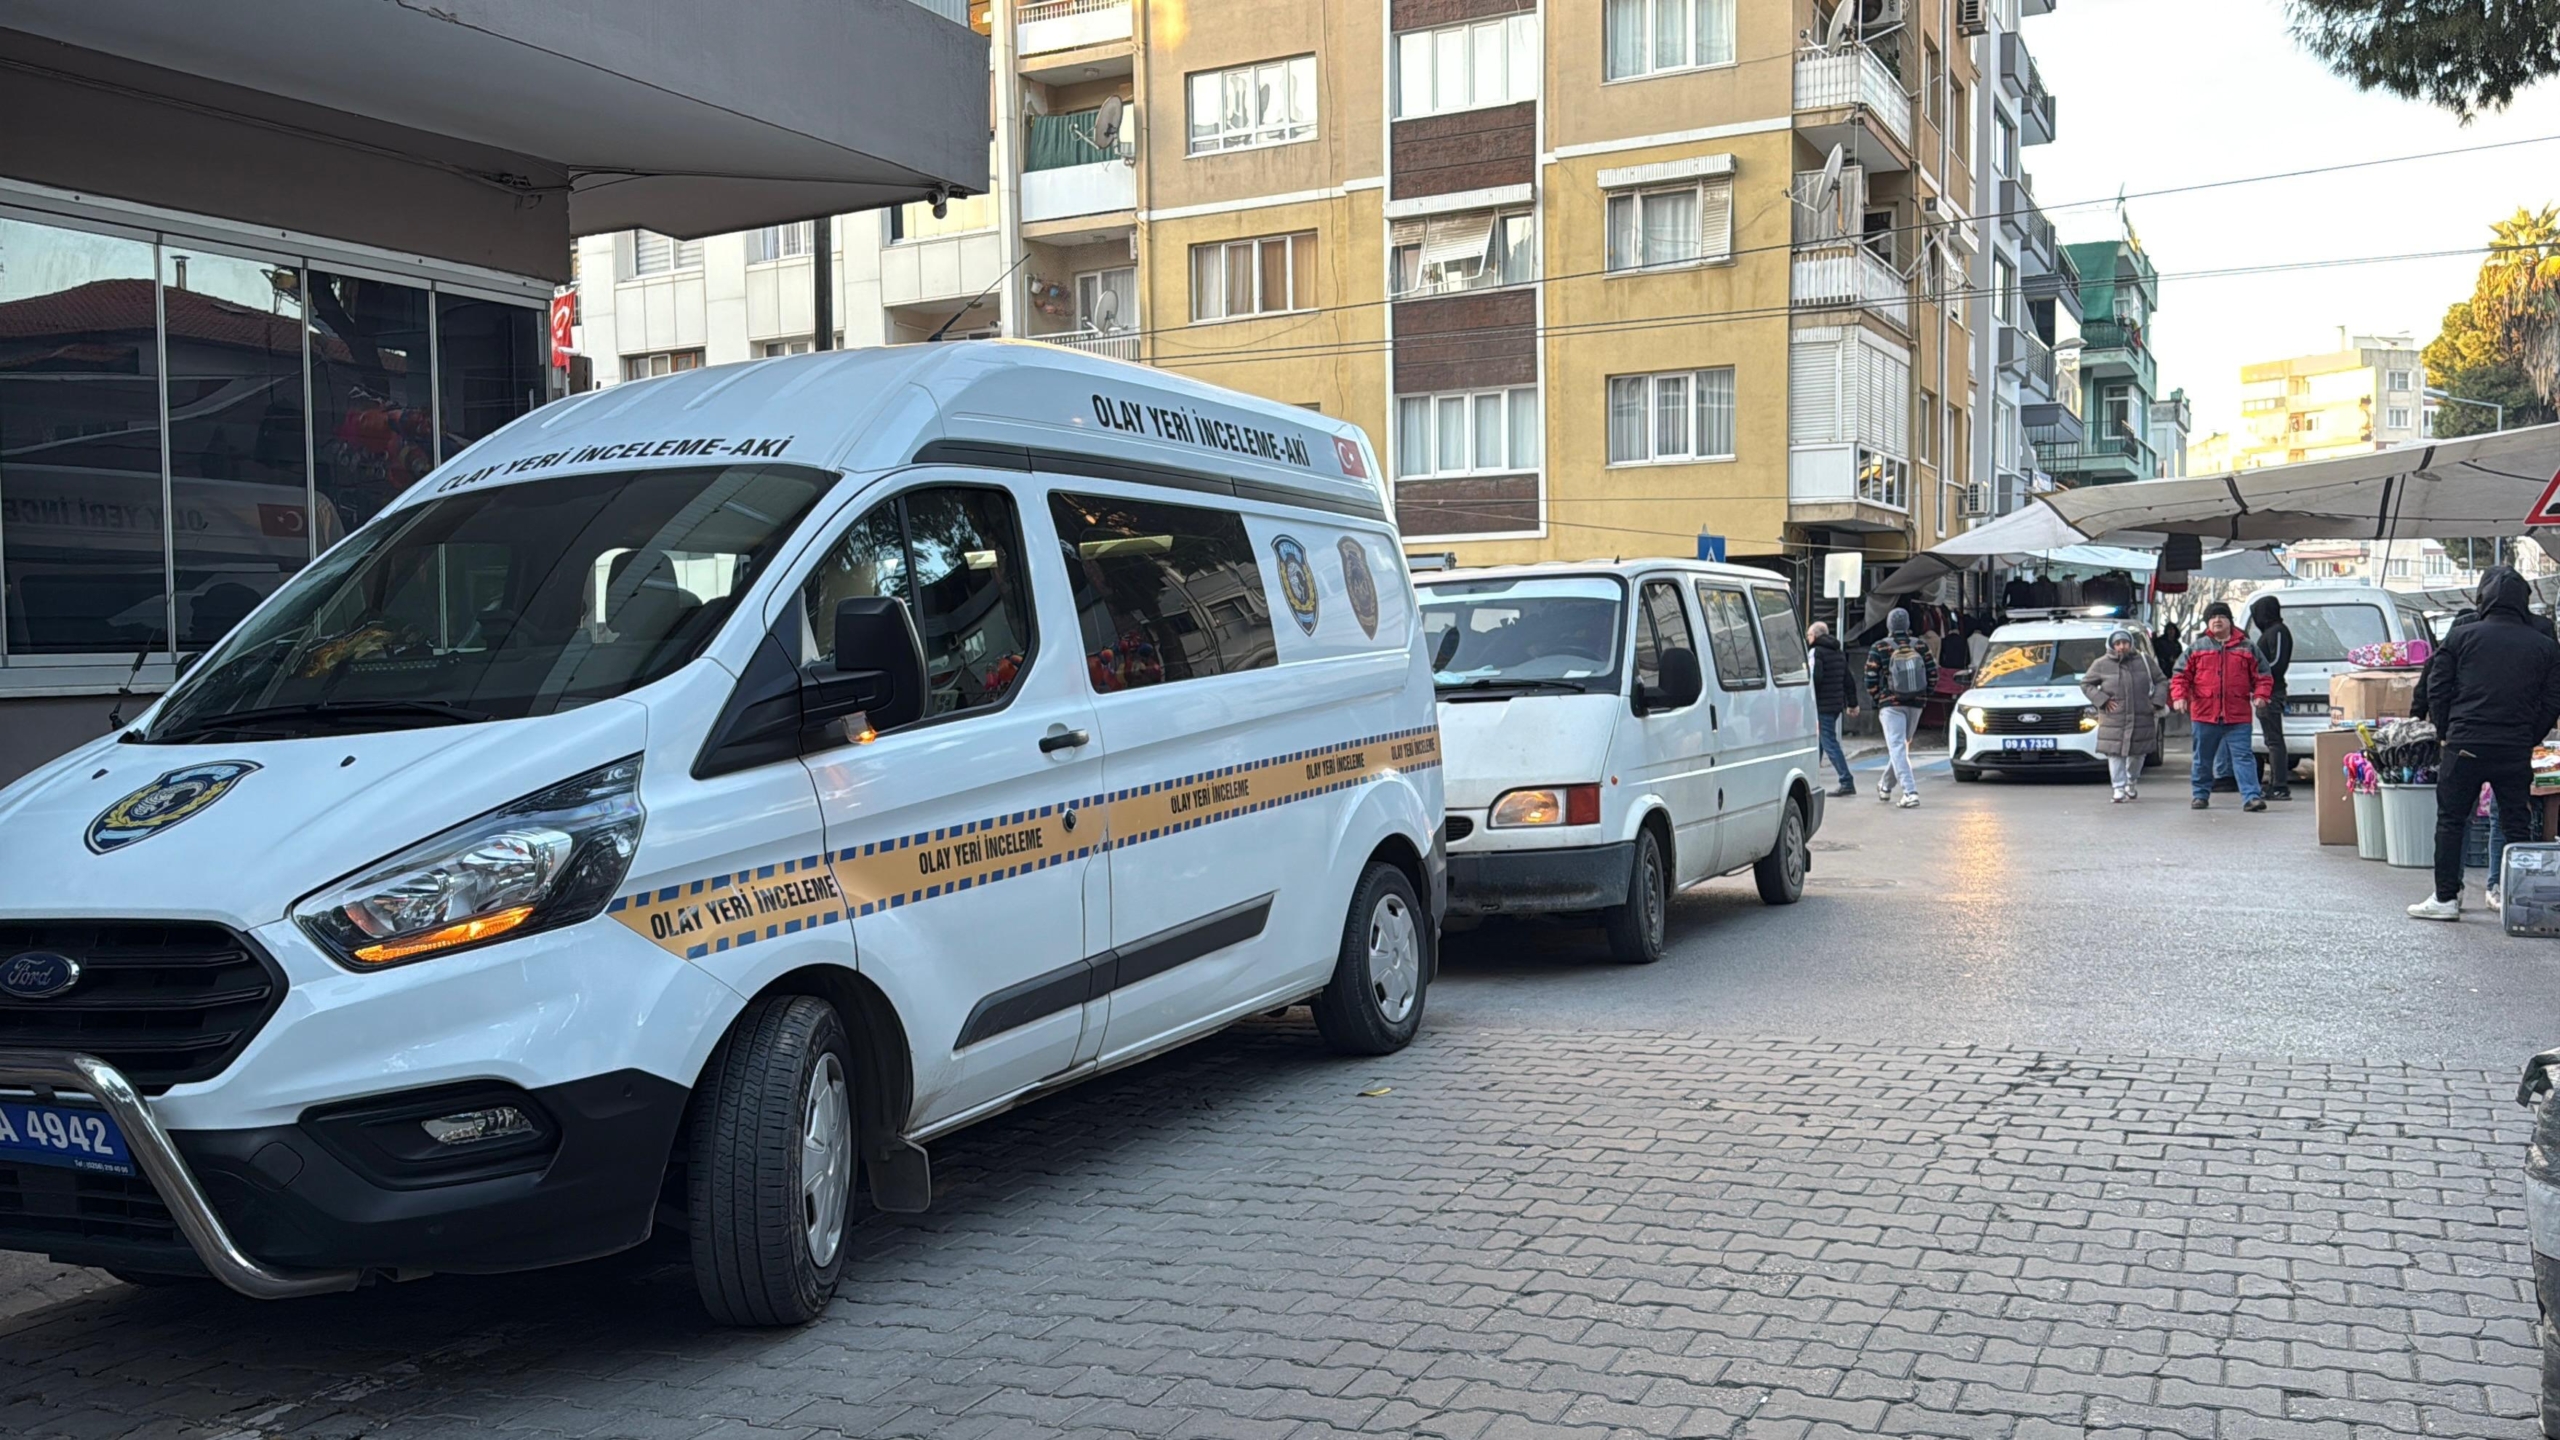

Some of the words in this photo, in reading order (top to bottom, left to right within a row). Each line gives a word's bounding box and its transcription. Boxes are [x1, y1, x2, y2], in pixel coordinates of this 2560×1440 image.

[1092, 394, 1145, 434] OLAY
[1147, 405, 1195, 443] YERİ
[1193, 408, 1311, 467] İNCELEME-AKİ
[501, 447, 571, 476] YERİ
[568, 436, 795, 465] İNCELEME-AKİ
[2020, 739, 2028, 749] A
[1306, 762, 1321, 780] OLAY
[1322, 754, 1336, 776] YERİ
[1336, 752, 1365, 773] İNCELEME
[1170, 792, 1191, 814] OLAY
[1192, 783, 1211, 808] YERİ
[1211, 779, 1250, 803] İNCELEME
[918, 846, 951, 875] OLAY
[953, 835, 982, 867] YERİ
[984, 827, 1043, 860] İNCELEME
[651, 905, 703, 940] OLAY
[705, 888, 754, 925] YERİ
[751, 874, 838, 914] İNCELEME
[8, 958, 55, 986] Ford
[27, 1110, 114, 1155] 4942
